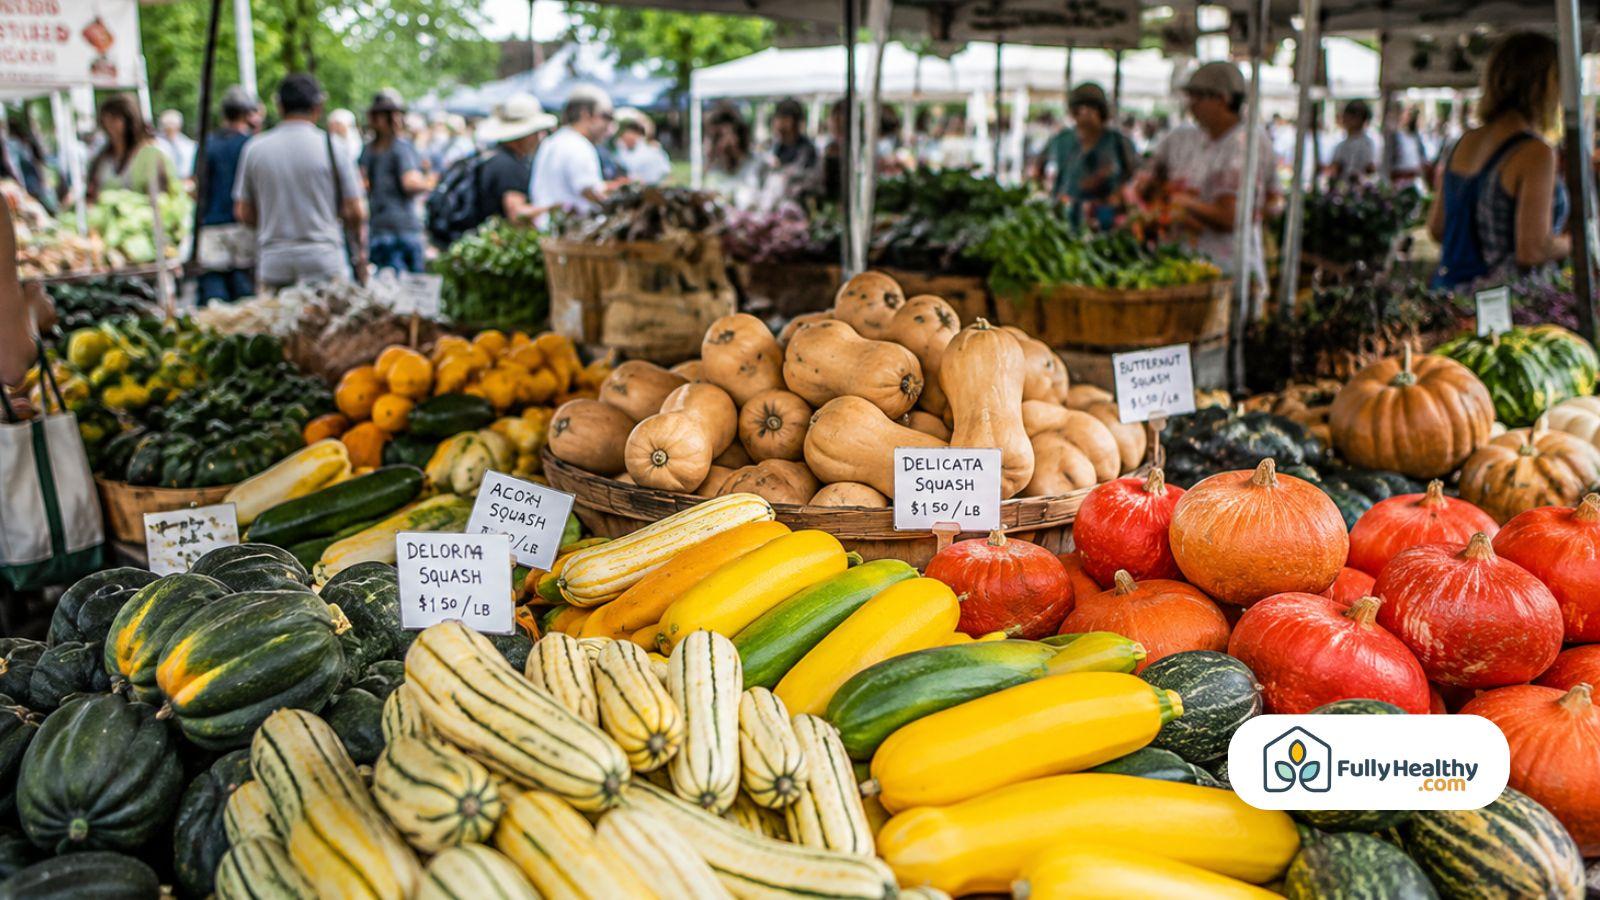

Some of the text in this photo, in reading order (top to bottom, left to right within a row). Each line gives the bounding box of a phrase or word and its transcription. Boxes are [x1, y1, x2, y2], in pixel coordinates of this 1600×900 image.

[1119, 353, 1181, 375] BUTTERNUT
[1130, 373, 1171, 390] SQUASH
[902, 456, 984, 472] DELICATA
[488, 502, 546, 530] SQUASH
